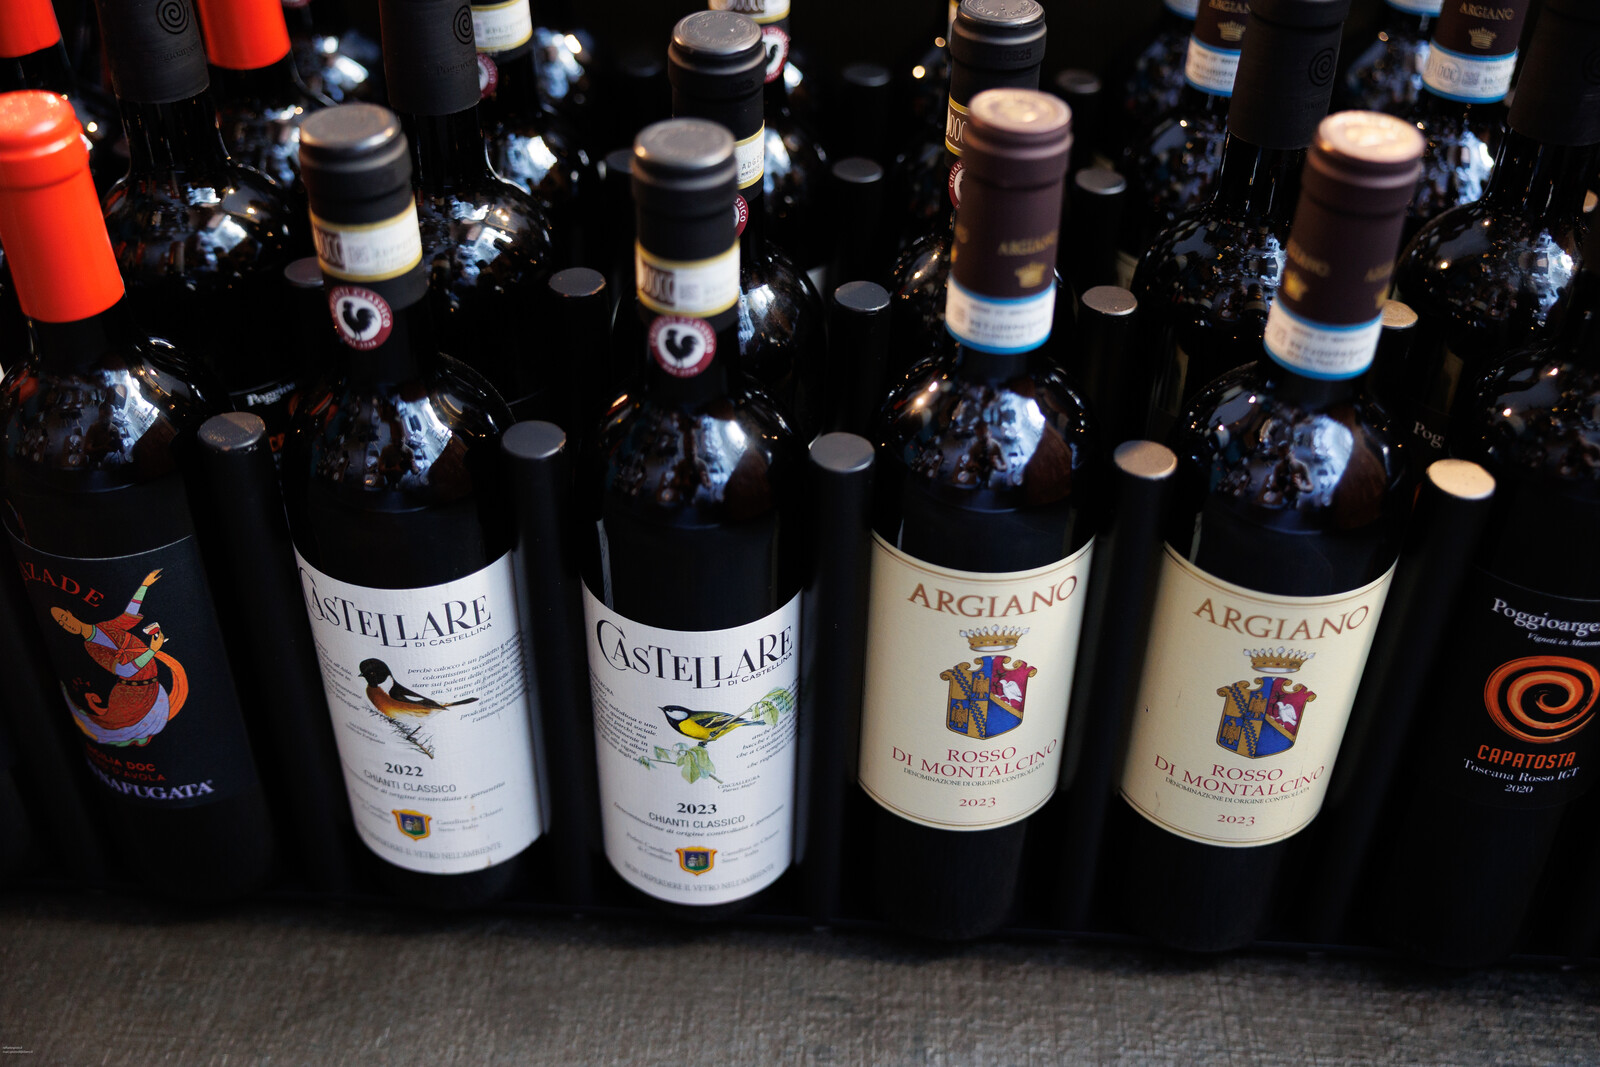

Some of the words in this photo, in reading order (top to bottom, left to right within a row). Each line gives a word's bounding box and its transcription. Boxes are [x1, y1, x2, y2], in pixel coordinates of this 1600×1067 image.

[1460, 2, 1515, 20] ARGIANO
[735, 197, 747, 223] SSICO
[299, 566, 491, 648] CASTELLARE
[907, 575, 1078, 618] ARGIANO
[1192, 597, 1370, 640] ARGIANO
[430, 622, 492, 647] CASTELLINA
[596, 619, 793, 689] CASTELLARE
[728, 679, 738, 687] DI
[741, 652, 793, 683] CASTELLINA
[126, 760, 156, 773] DOC
[892, 745, 913, 766] DI
[921, 738, 1057, 779] MONTALCINO
[946, 746, 1017, 764] ROSSO
[1477, 744, 1577, 769] CAPATOSTA
[363, 769, 401, 790] CHIANTI
[403, 782, 457, 794] CLASSICO
[384, 762, 424, 777] 2022
[903, 767, 962, 787] DENOMINAZIONE
[971, 779, 1001, 787] ORIGINE
[1154, 754, 1176, 777] DI
[1182, 765, 1325, 797] MONTALCINO
[1211, 763, 1284, 783] ROSSO
[1463, 758, 1514, 781] Toscana
[1518, 772, 1555, 783] Rosso
[1557, 766, 1580, 781] IGT
[1165, 776, 1224, 802] DENOMINAZIONE
[1233, 797, 1264, 805] ORIGINE
[1504, 783, 1535, 794] 2020
[676, 802, 718, 815] 2023
[958, 797, 997, 808] 2023
[648, 812, 690, 828] CHIANTI
[692, 814, 746, 829] CLASSICO
[1217, 814, 1256, 827] 2023
